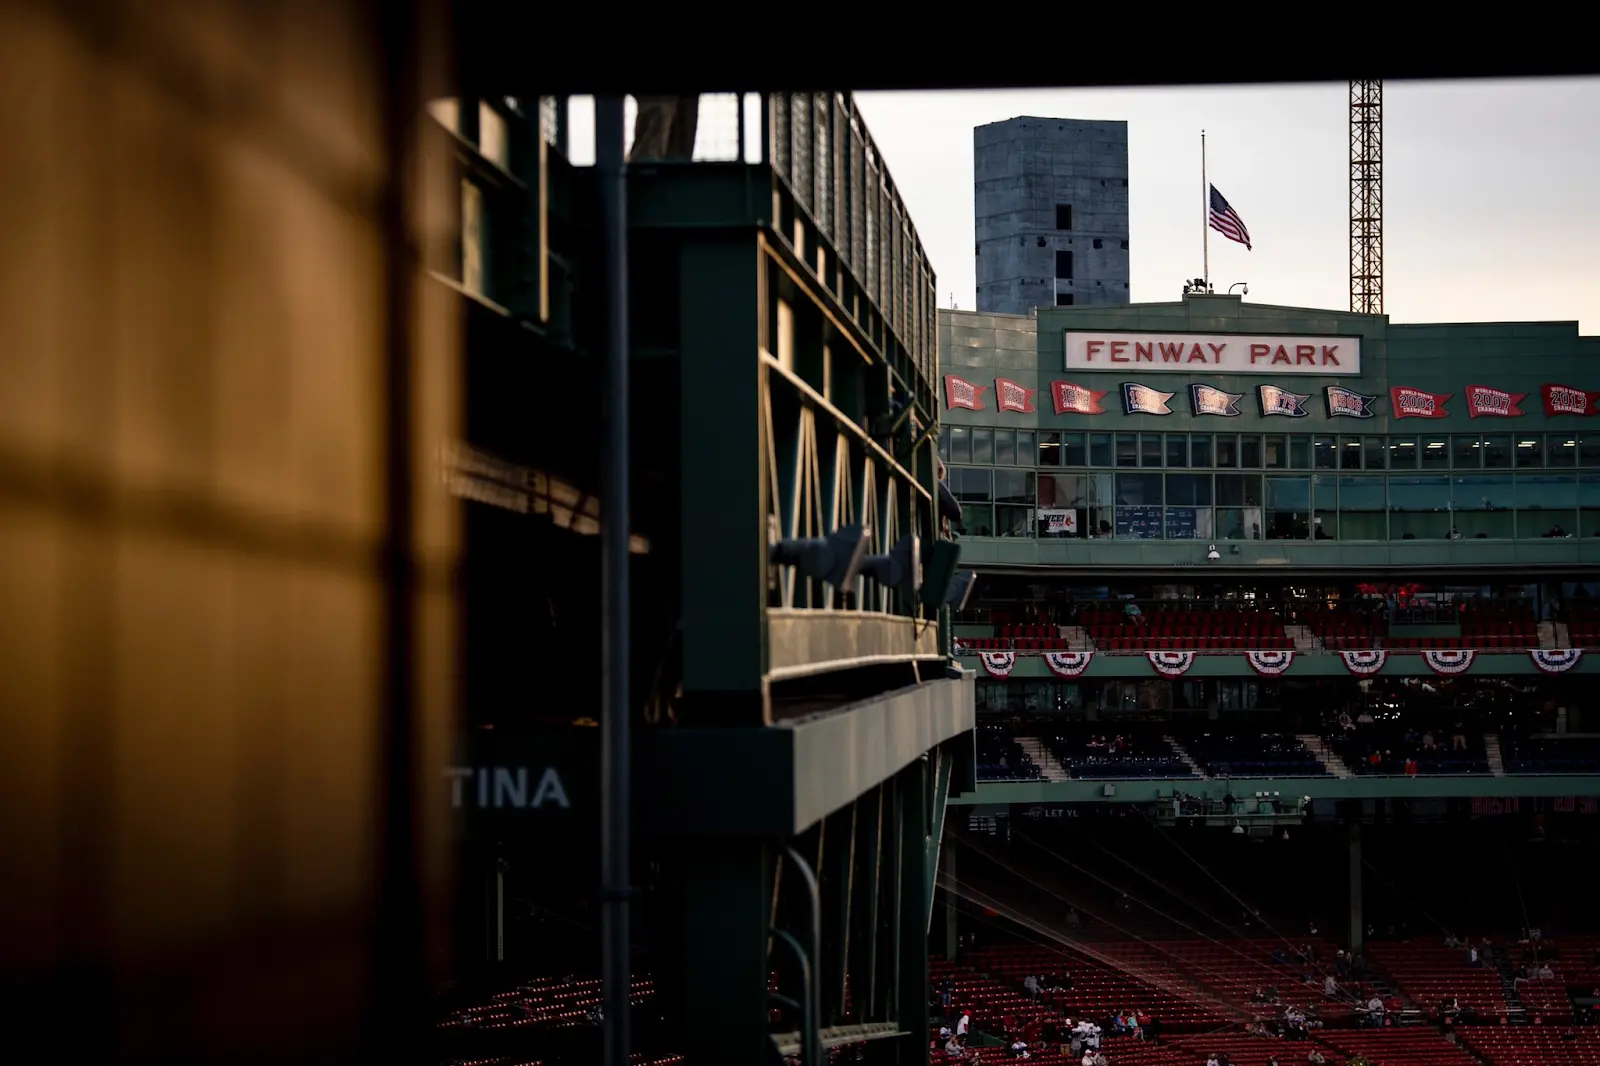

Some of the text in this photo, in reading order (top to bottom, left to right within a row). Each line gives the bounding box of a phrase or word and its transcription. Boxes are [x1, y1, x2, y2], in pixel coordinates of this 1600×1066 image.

[1086, 340, 1341, 366] FENWAY PARK
[1492, 389, 1509, 398] SERIES
[1568, 388, 1586, 397] SERIES
[1266, 392, 1296, 411] 1975
[1399, 395, 1435, 411] 2004
[1472, 392, 1511, 409] 2007
[1550, 391, 1587, 409] 2013
[1335, 407, 1361, 416] CHAMPIONS
[1403, 407, 1432, 416] CHAMPIONS
[1477, 406, 1508, 415] CHAMPIONS
[1553, 404, 1585, 414] CHAMPIONS
